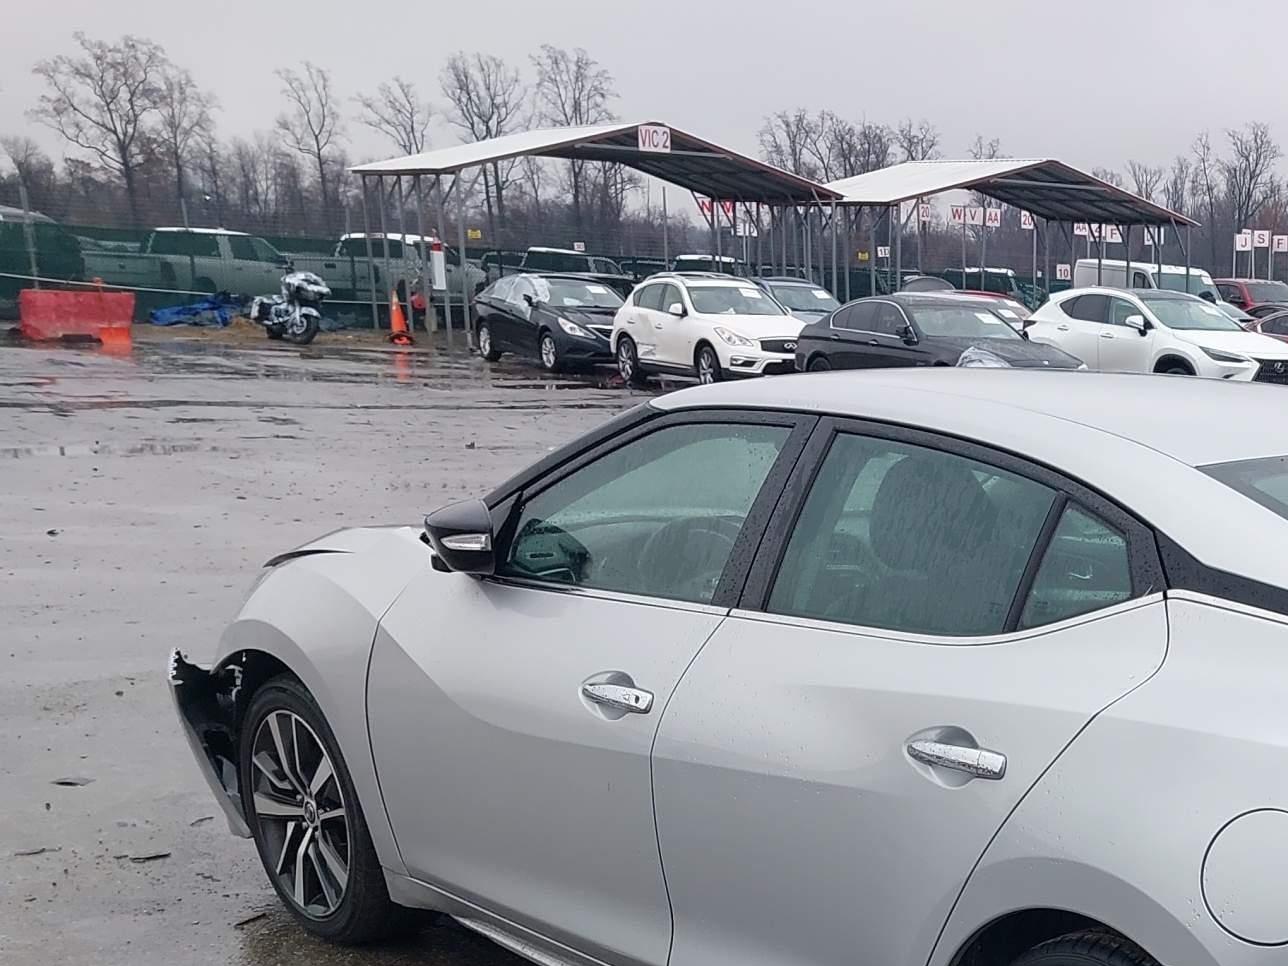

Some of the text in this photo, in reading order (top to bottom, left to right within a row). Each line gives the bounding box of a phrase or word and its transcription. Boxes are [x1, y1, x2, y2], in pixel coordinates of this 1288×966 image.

[640, 129, 669, 149] VIC 2
[921, 206, 929, 218] 20
[951, 208, 962, 221] W
[969, 209, 977, 221] V
[987, 212, 999, 223] AA
[1110, 228, 1117, 239] F
[1257, 233, 1265, 244] S
[1241, 236, 1248, 248] J
[1276, 238, 1284, 249] F
[1058, 268, 1069, 278] 10
